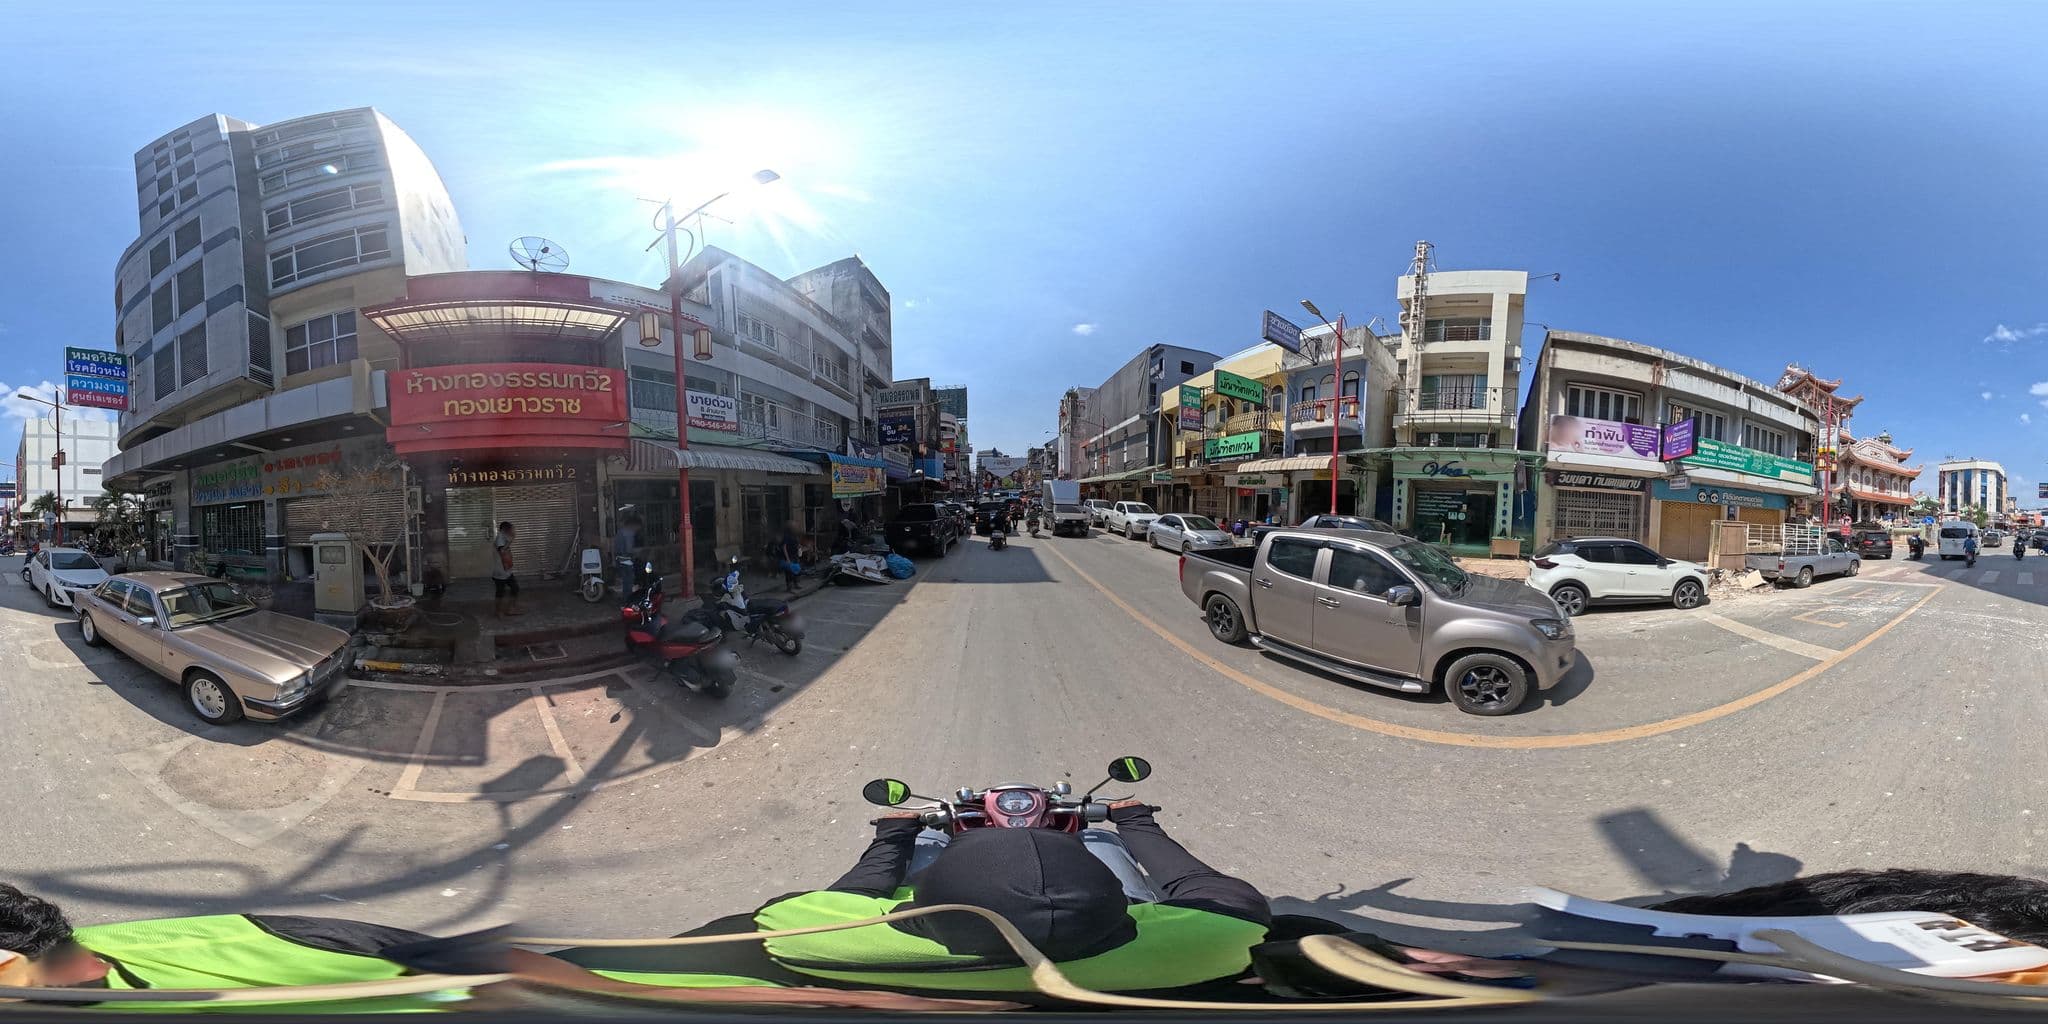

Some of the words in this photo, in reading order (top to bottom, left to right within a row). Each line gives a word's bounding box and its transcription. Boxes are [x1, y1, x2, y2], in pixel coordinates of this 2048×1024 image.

[68, 360, 126, 377] โรคผิวหนัง
[71, 379, 124, 393] ความงาม
[406, 369, 612, 394] ห้างทองธรรมทวี2
[72, 391, 123, 405] ศูนย์เลเซอร์
[690, 395, 733, 409] ขายด่วน
[444, 396, 581, 416] ทองเยาวราช
[1585, 426, 1625, 442] ทำฟัน
[567, 468, 576, 479] 2
